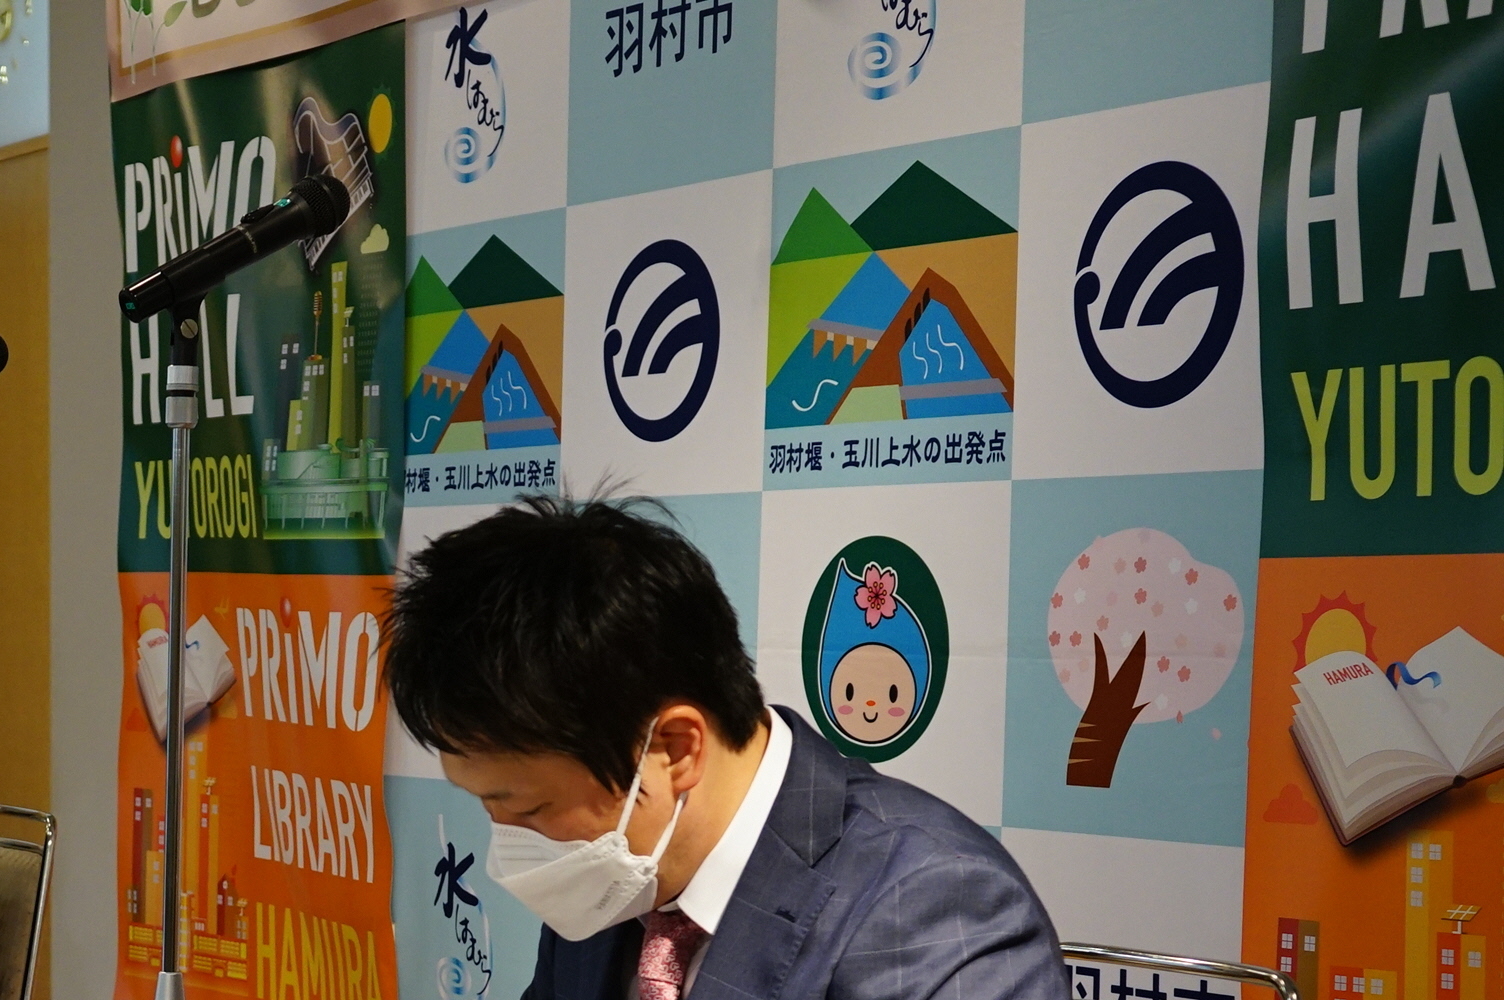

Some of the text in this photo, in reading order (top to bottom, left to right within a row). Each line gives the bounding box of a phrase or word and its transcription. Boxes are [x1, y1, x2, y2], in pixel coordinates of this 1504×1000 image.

[604, 0, 733, 78] 羽村市
[129, 293, 254, 425] HLL
[769, 429, 1007, 474] 羽村堰・玉川上水の出発点
[1291, 355, 1504, 501] YUTO
[134, 454, 257, 539] YUOROGI
[404, 458, 556, 493] 村堰・玉川上水の出発点
[1323, 662, 1374, 686] HAMURA
[251, 765, 374, 883] LIBRARY
